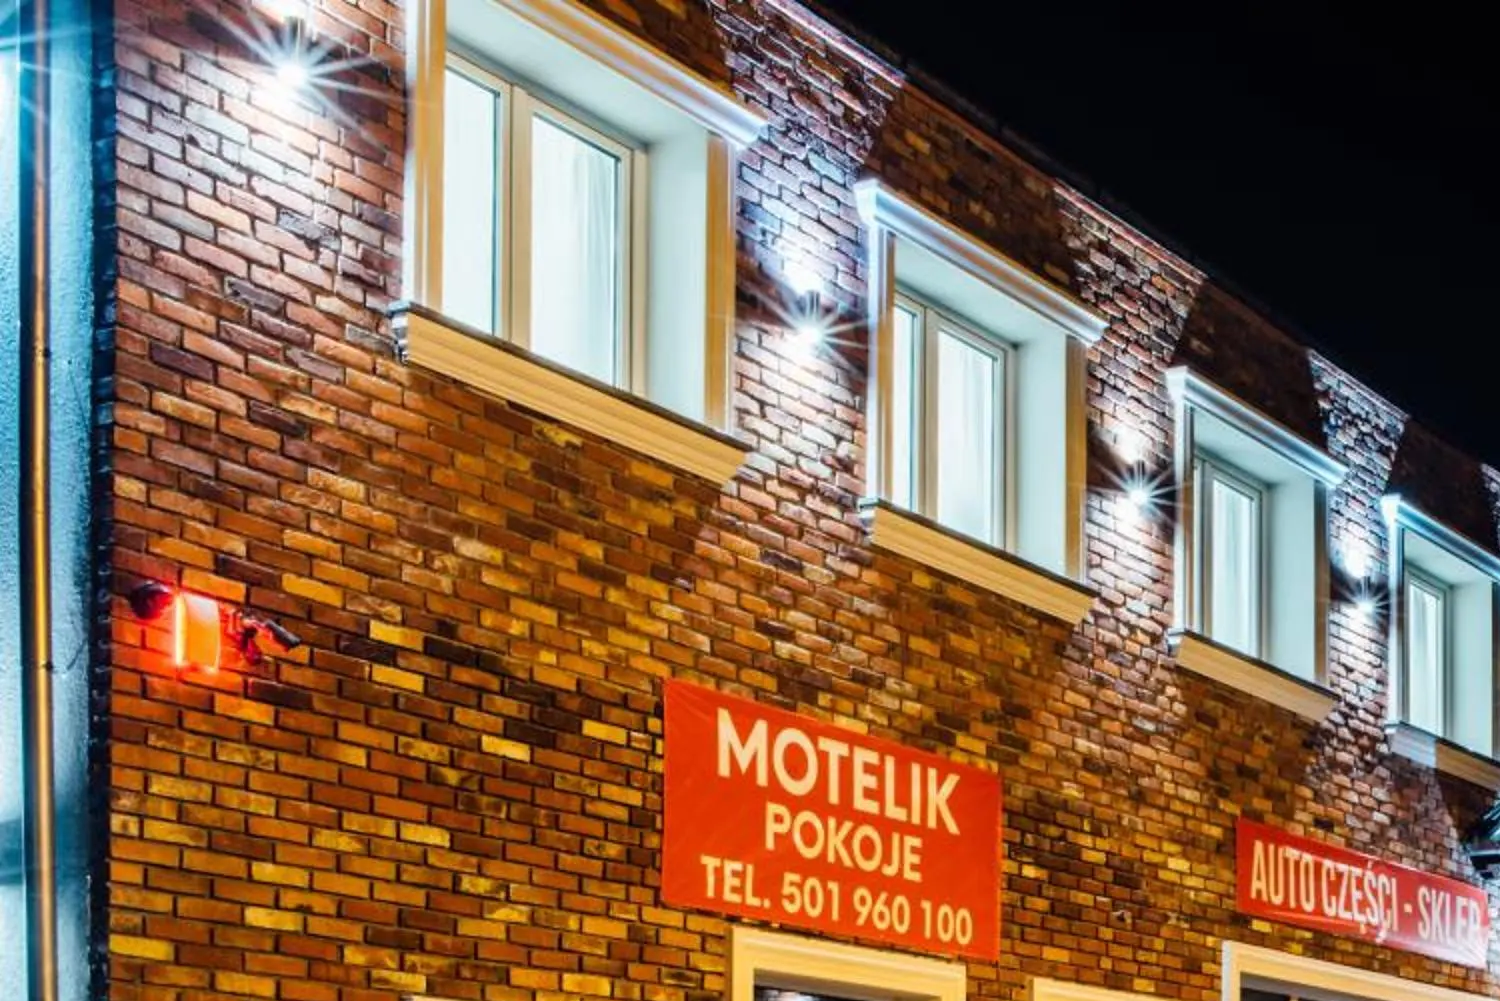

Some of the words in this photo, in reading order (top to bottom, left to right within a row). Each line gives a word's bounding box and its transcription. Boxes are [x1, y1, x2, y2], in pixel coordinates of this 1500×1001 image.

[717, 707, 960, 835] MOTELIK
[765, 801, 923, 883] POKOJE
[701, 854, 771, 910] TEL.
[781, 871, 840, 921] 501
[853, 887, 911, 935] 960
[920, 900, 973, 946] 100
[1251, 839, 1315, 913] AUTO
[1321, 860, 1398, 935] CZĘŚCI
[1417, 885, 1481, 949] SKLEP
